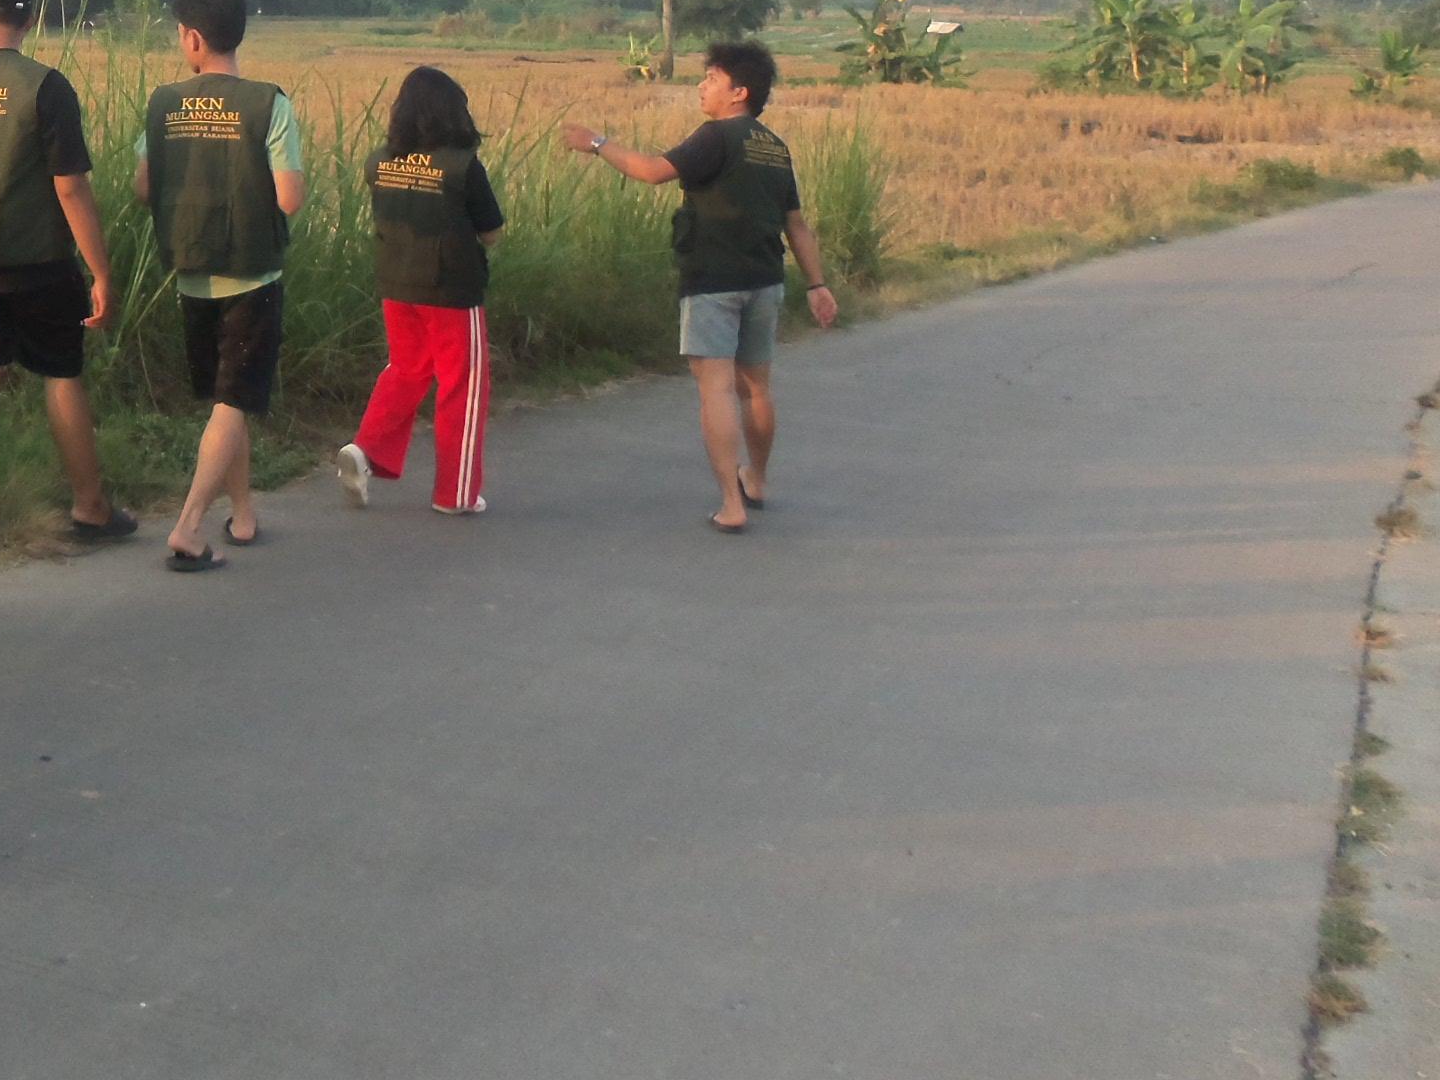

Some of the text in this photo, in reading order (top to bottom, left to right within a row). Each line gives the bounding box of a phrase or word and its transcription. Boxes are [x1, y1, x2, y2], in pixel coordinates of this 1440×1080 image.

[181, 97, 225, 110] KKN
[165, 110, 241, 121] MULANGSARI
[378, 161, 444, 177] MULANGSARI
